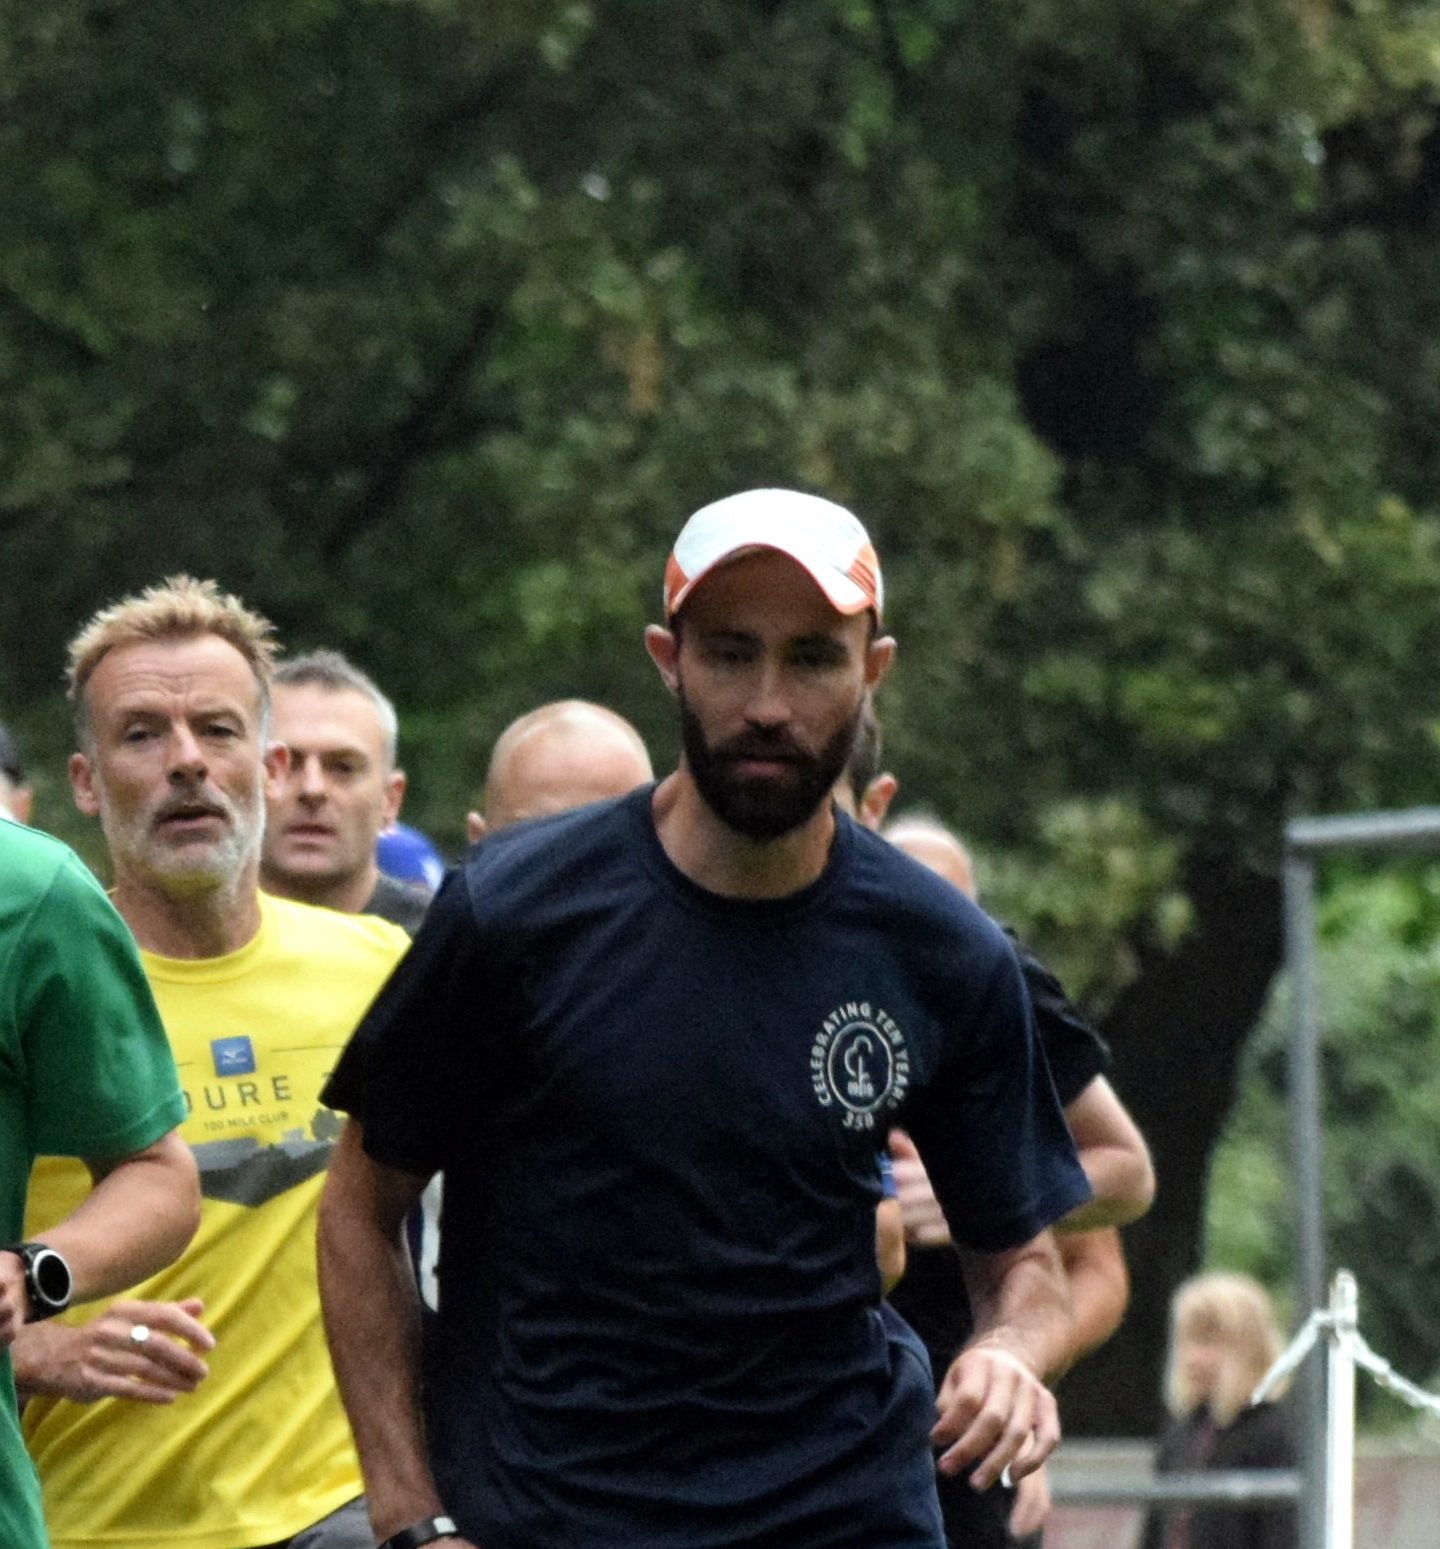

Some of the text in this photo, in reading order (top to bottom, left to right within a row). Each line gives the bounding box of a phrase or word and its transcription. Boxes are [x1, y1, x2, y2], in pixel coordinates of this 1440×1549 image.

[810, 1001, 872, 1106] CELEBRATING
[876, 1008, 906, 1046] TEN
[227, 1115, 257, 1128] MILE
[258, 1110, 289, 1124] CLUB
